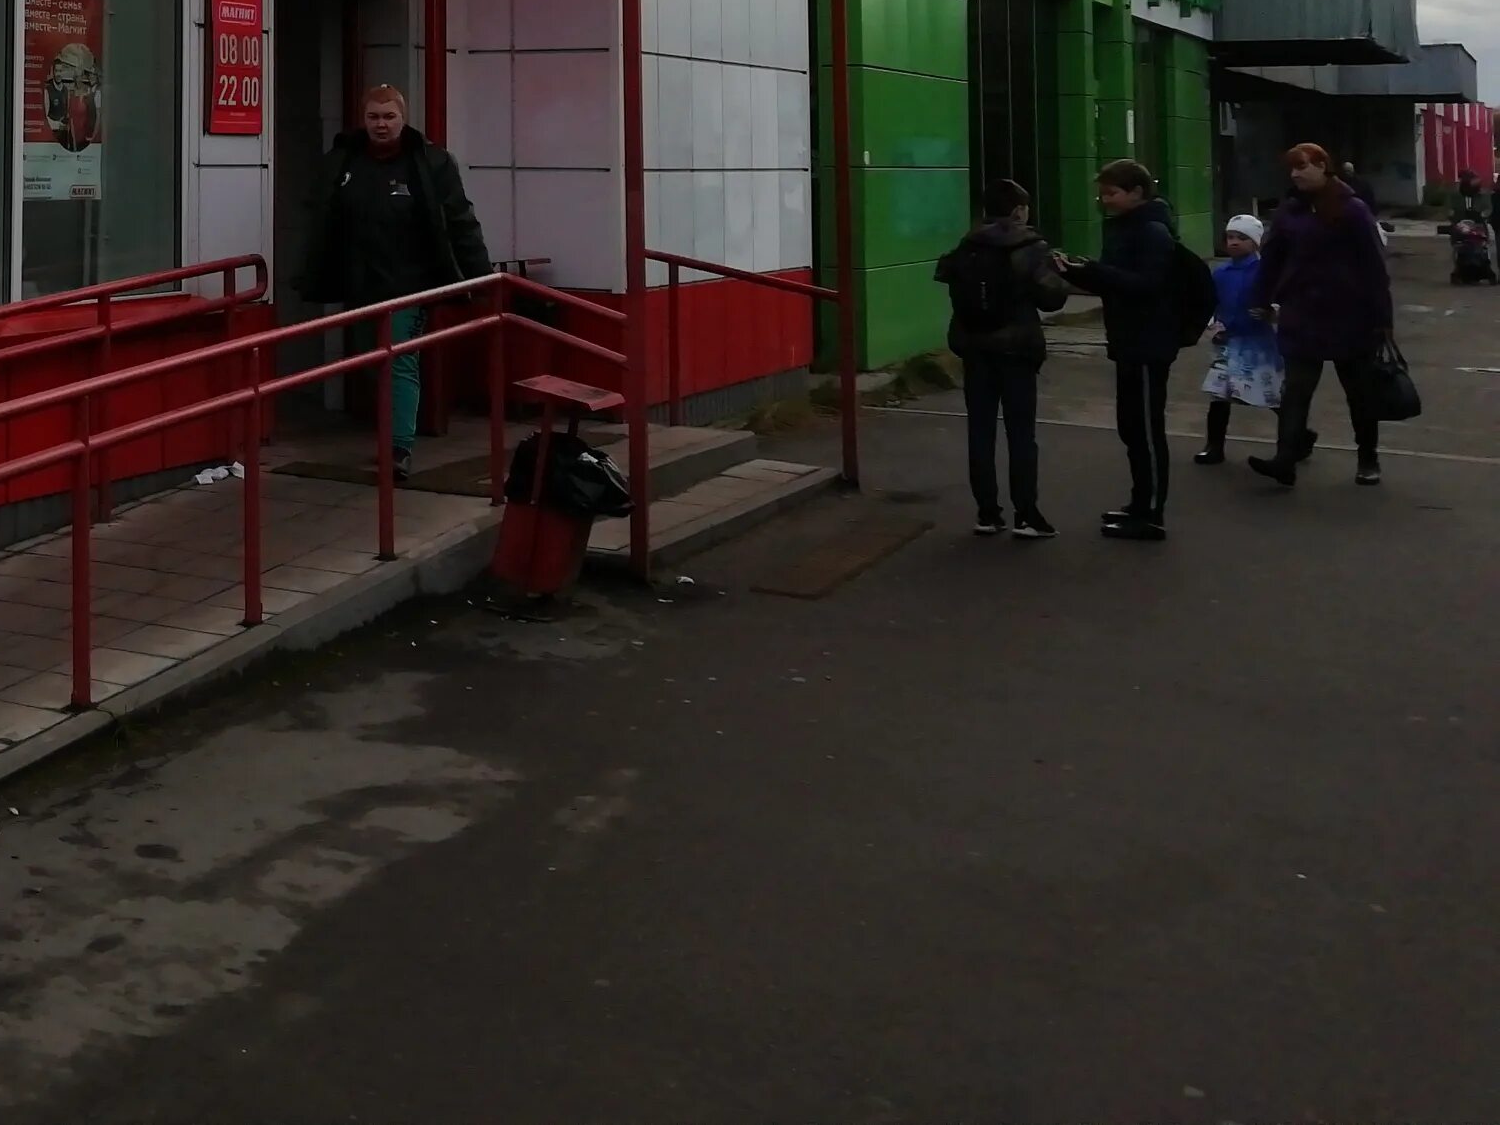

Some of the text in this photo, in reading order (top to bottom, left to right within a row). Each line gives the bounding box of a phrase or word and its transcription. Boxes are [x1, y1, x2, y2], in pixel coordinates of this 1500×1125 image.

[221, 6, 255, 21] МАГНИТ
[219, 33, 259, 66] 08 00
[218, 75, 259, 107] 22 00
